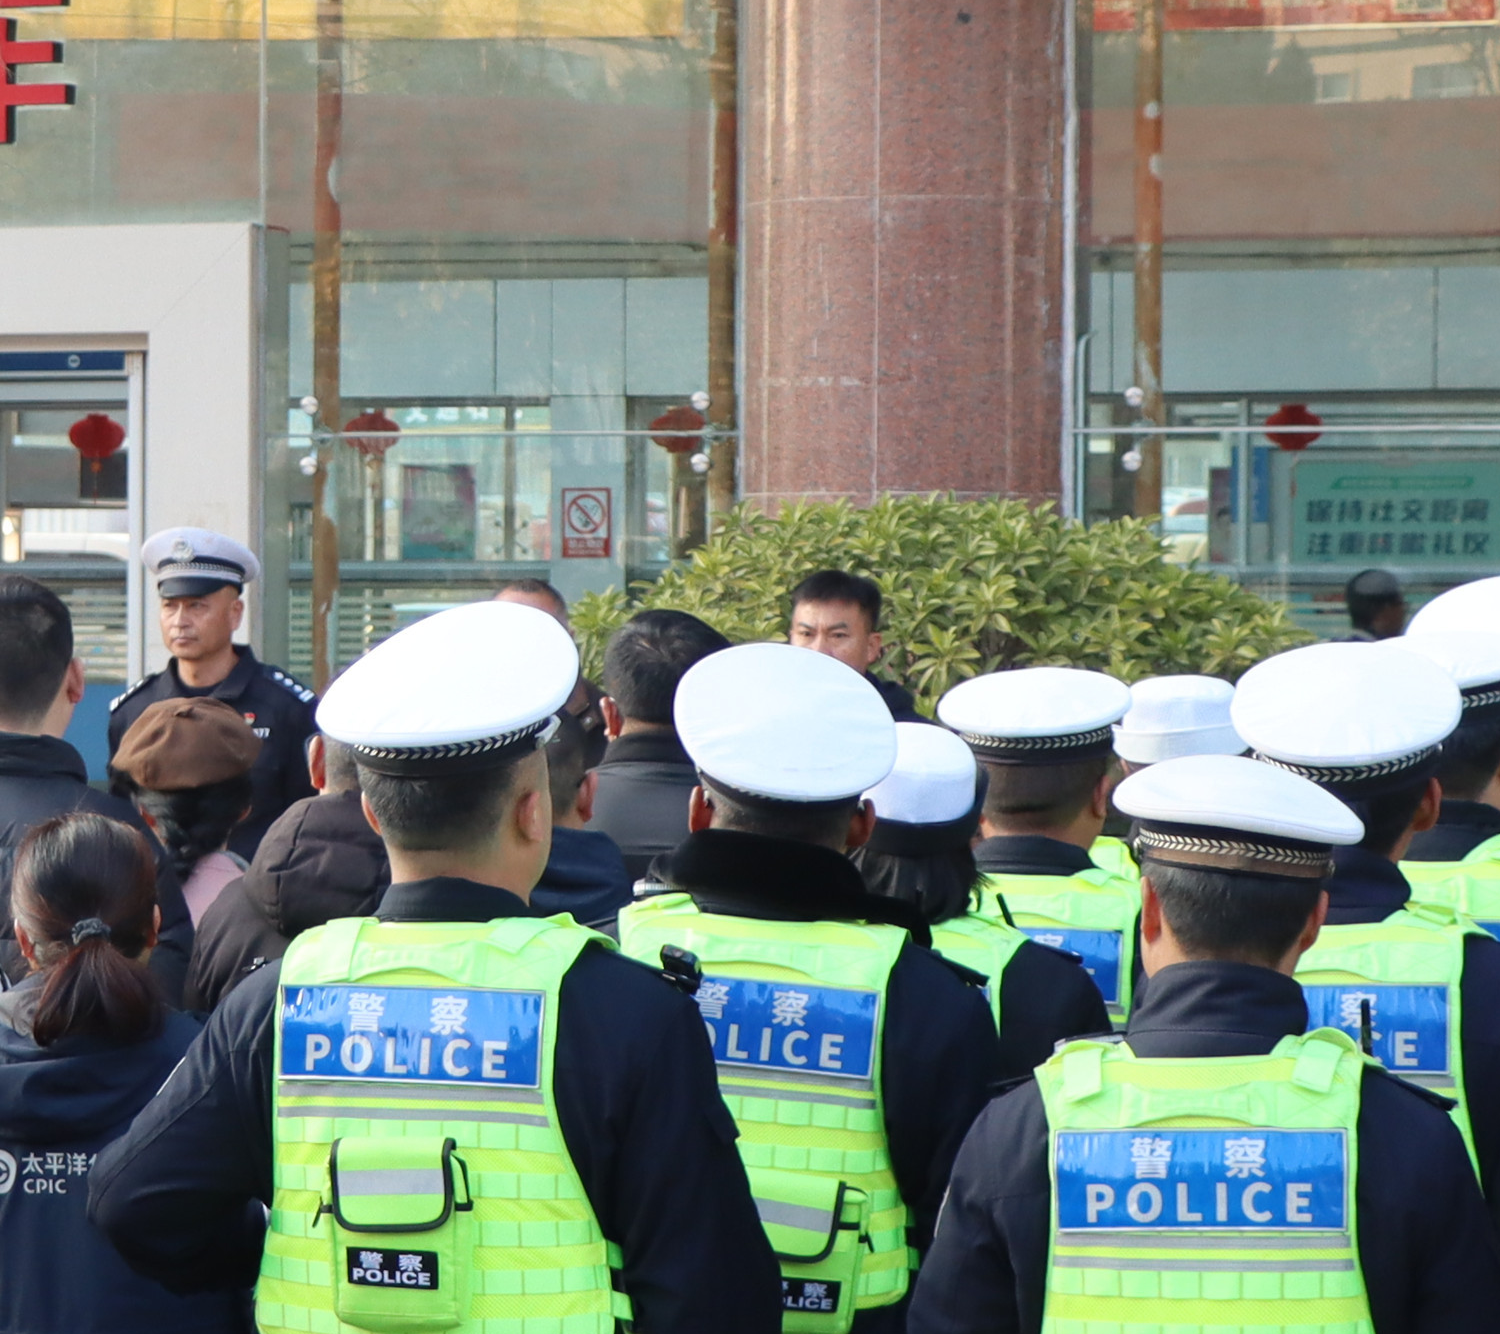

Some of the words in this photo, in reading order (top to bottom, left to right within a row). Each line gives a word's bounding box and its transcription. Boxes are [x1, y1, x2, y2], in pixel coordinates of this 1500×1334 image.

[347, 992, 469, 1036] 警察
[694, 981, 811, 1027] 警察
[304, 1033, 509, 1079] POLICE
[704, 1020, 845, 1070] LICE
[1130, 1136, 1267, 1180] 警察
[23, 1178, 67, 1194] CPIC
[1085, 1181, 1313, 1223] POLICE
[352, 1267, 431, 1286] POLICE
[359, 1250, 423, 1272] 警察
